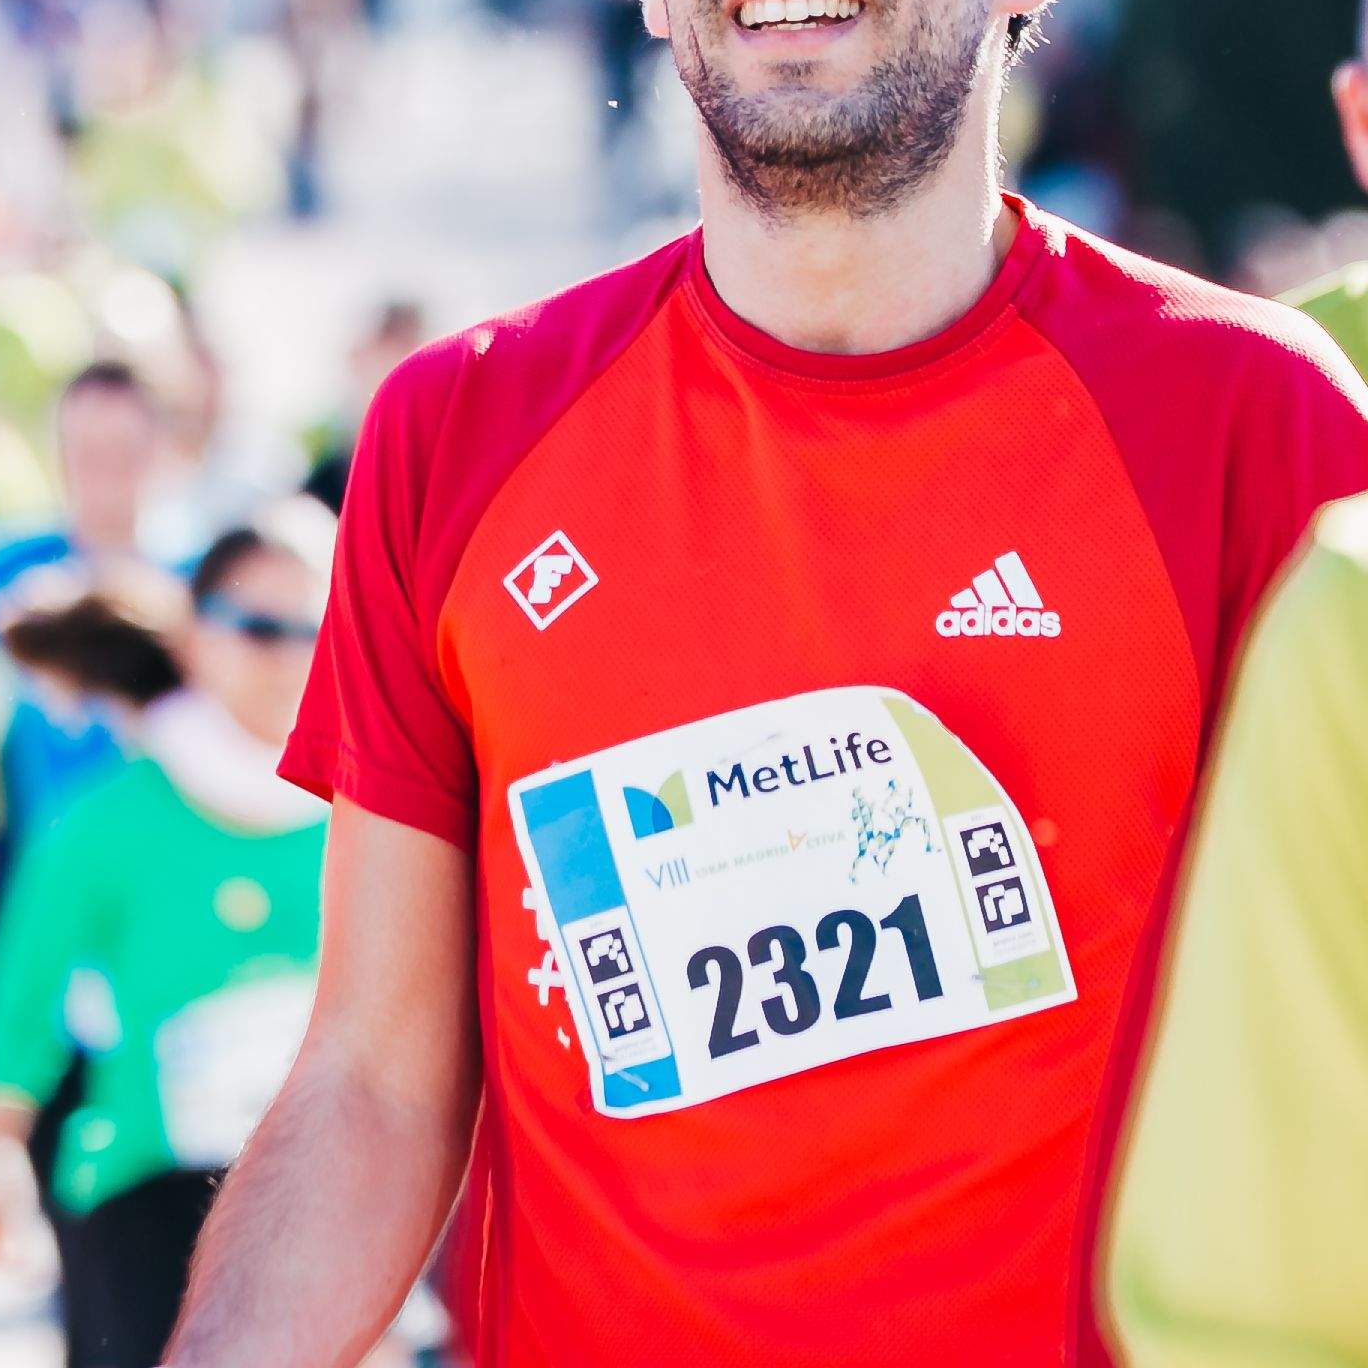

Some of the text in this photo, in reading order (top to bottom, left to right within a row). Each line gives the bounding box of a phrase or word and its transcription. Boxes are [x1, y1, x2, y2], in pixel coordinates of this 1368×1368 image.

[936, 602, 1061, 638] adidas
[706, 732, 893, 808] MetLife
[645, 857, 691, 891] VIII
[686, 892, 944, 1060] 2321
